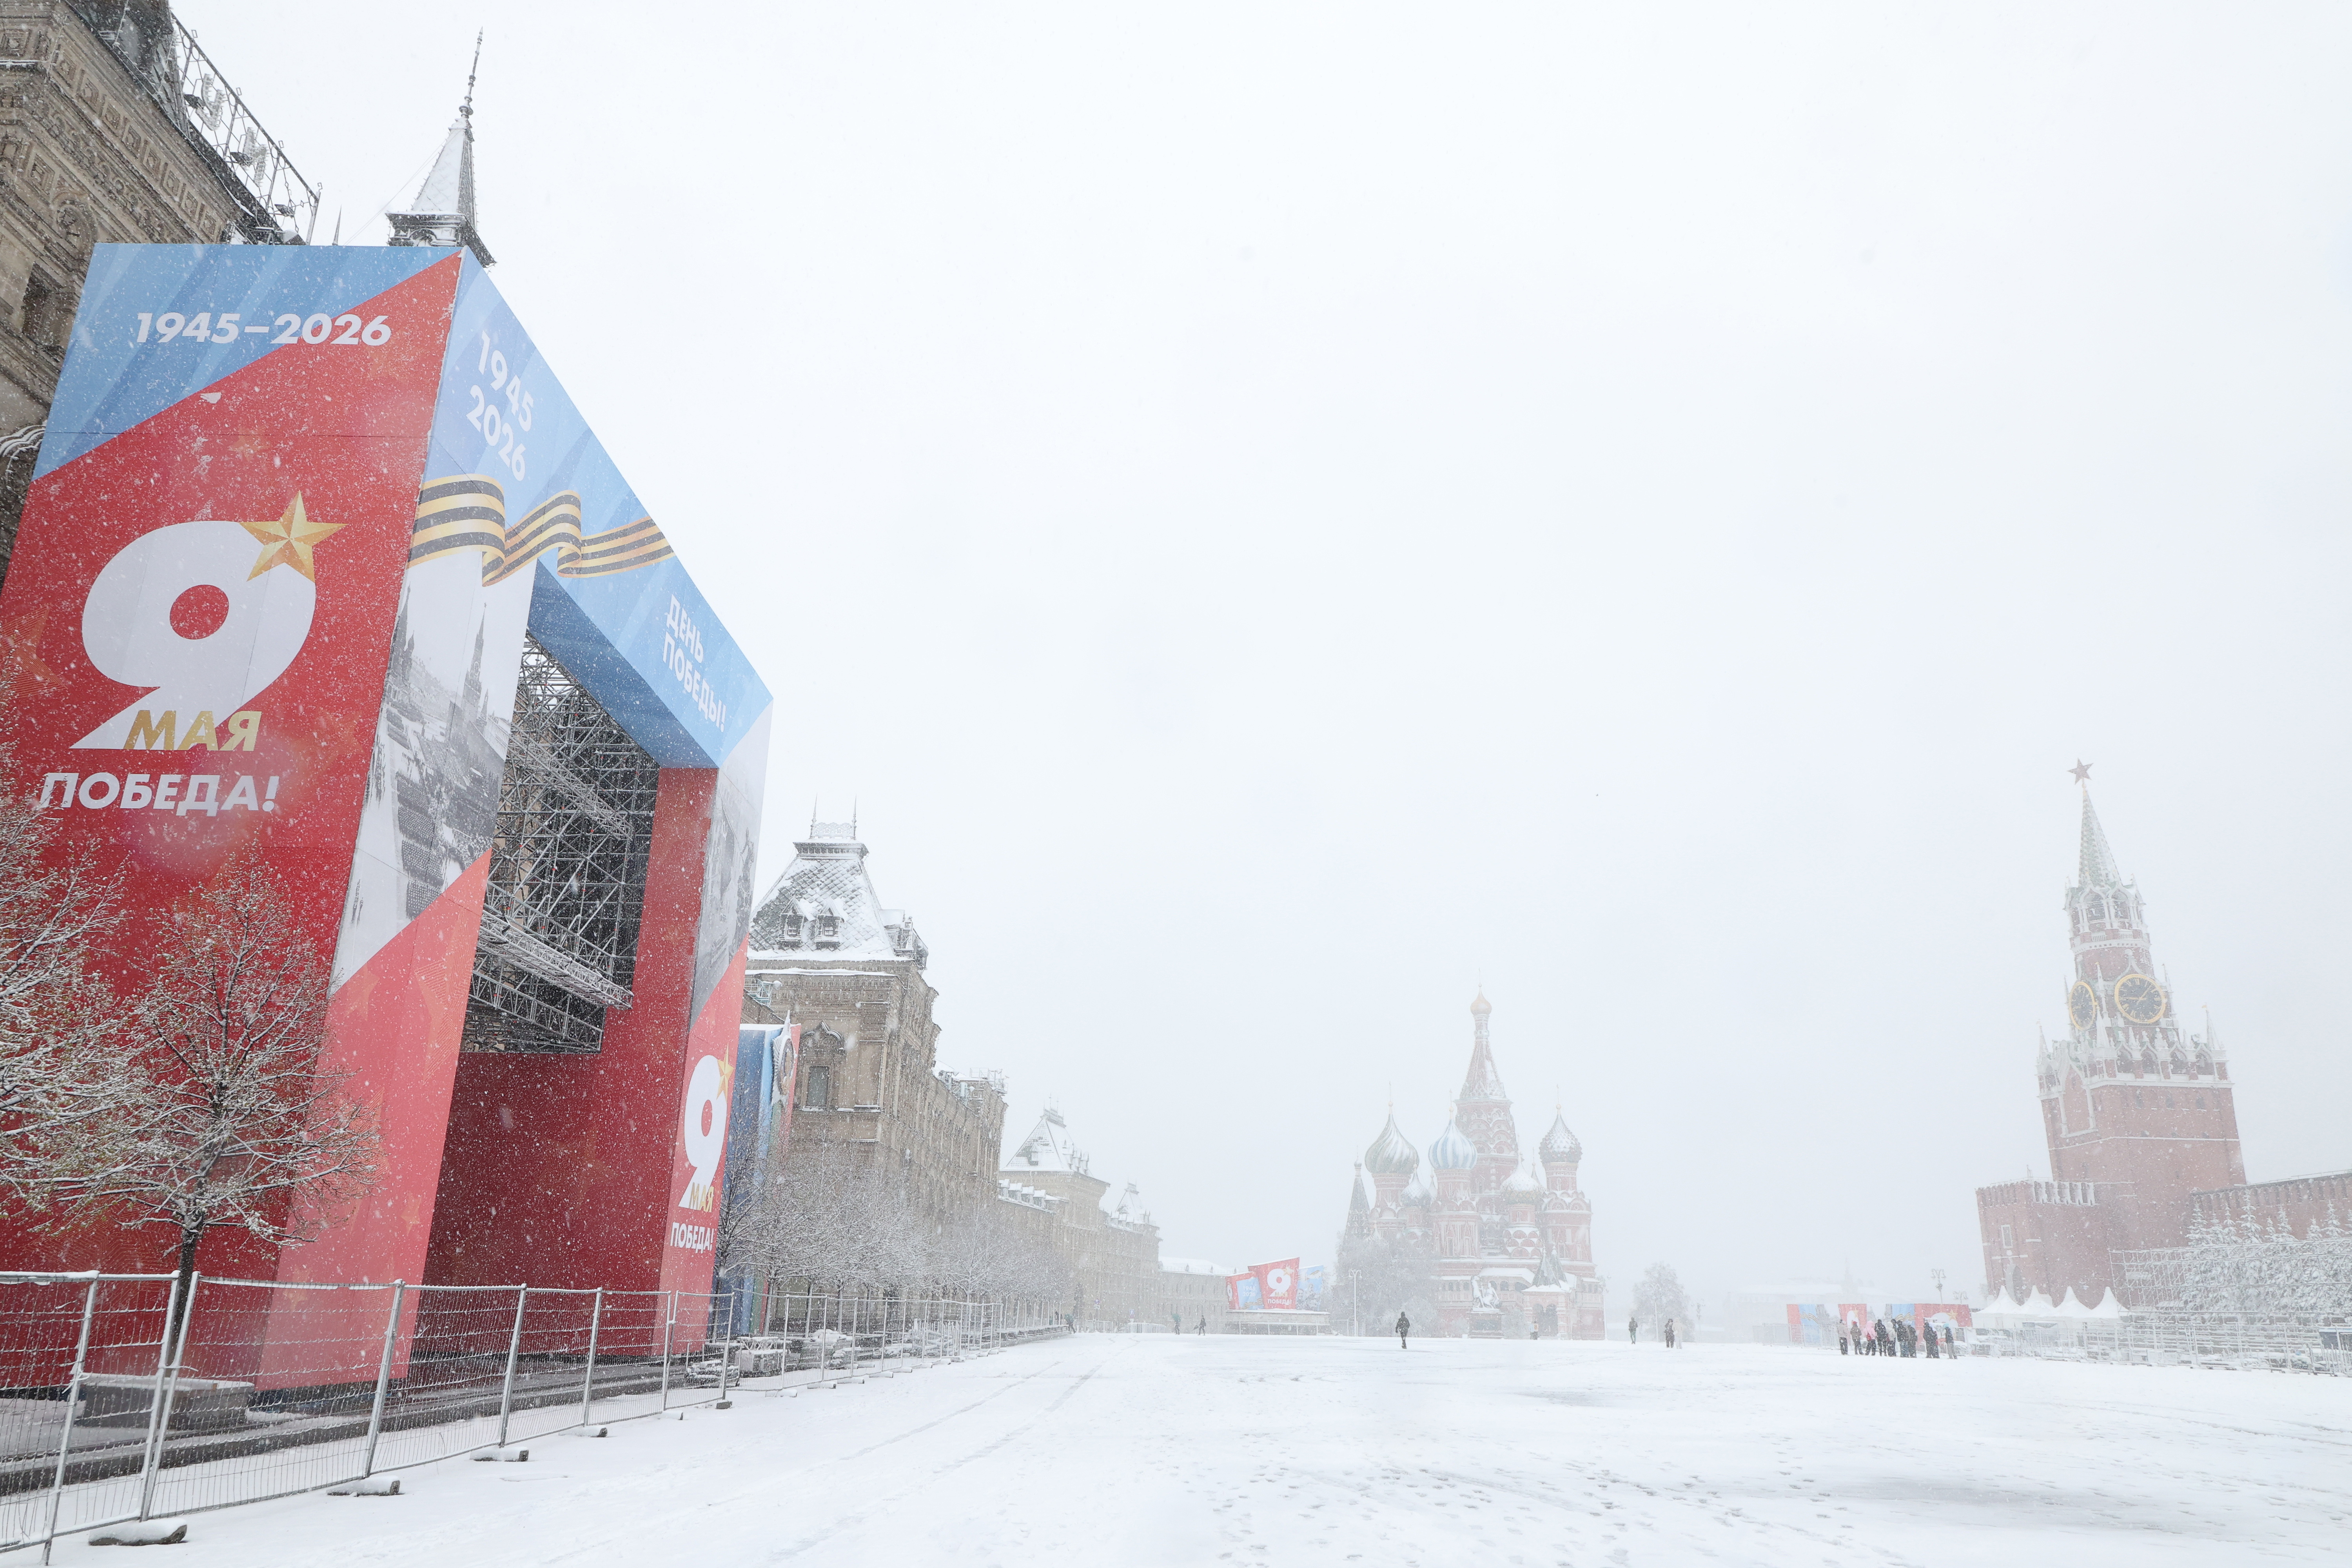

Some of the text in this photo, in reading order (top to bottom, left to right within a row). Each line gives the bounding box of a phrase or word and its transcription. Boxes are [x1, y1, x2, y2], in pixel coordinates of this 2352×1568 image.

[478, 330, 534, 432] 1945
[465, 385, 526, 481] 2026
[69, 521, 316, 750] 9
[666, 593, 704, 664] ДЕНЬ
[662, 631, 726, 733] ПОБЕДЫ!
[123, 710, 262, 751] МАЯ
[38, 772, 280, 817] ПОБЕДА!
[679, 1054, 727, 1210] 9
[688, 1182, 714, 1213] МАЯ
[670, 1222, 714, 1254] ПОБЕДА!
[1267, 1268, 1291, 1297] 9
